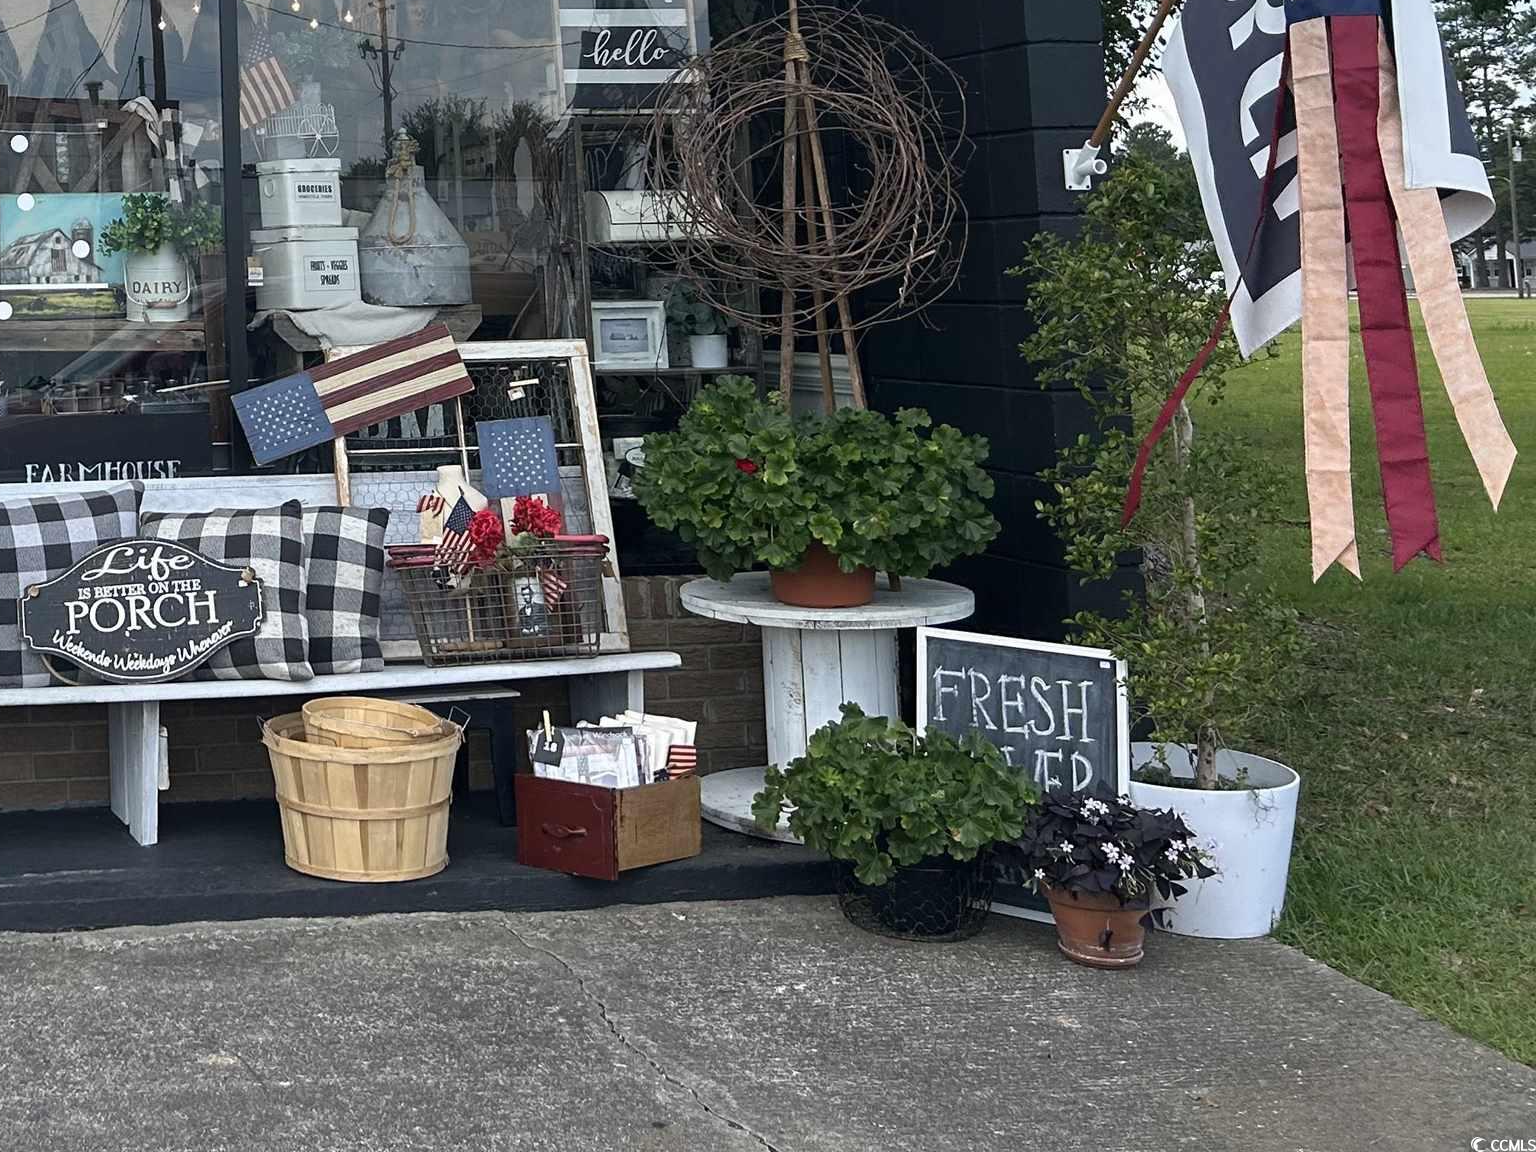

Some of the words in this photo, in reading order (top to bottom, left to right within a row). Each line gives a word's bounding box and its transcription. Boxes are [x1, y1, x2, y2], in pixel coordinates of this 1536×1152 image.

[583, 29, 670, 66] hello
[297, 184, 332, 193] GROCERIES
[132, 281, 182, 294] DAIRY
[25, 460, 181, 483] FARMHOUSE
[81, 546, 195, 581] Life
[78, 587, 91, 600] IS
[94, 584, 146, 599] BETTER
[148, 581, 168, 593] ON
[171, 579, 201, 592] THE
[64, 591, 219, 635] PORCH
[53, 629, 112, 668] Weekends
[114, 652, 177, 674] Weekdays
[176, 620, 233, 663] Whenever
[933, 665, 1096, 742] FRESH
